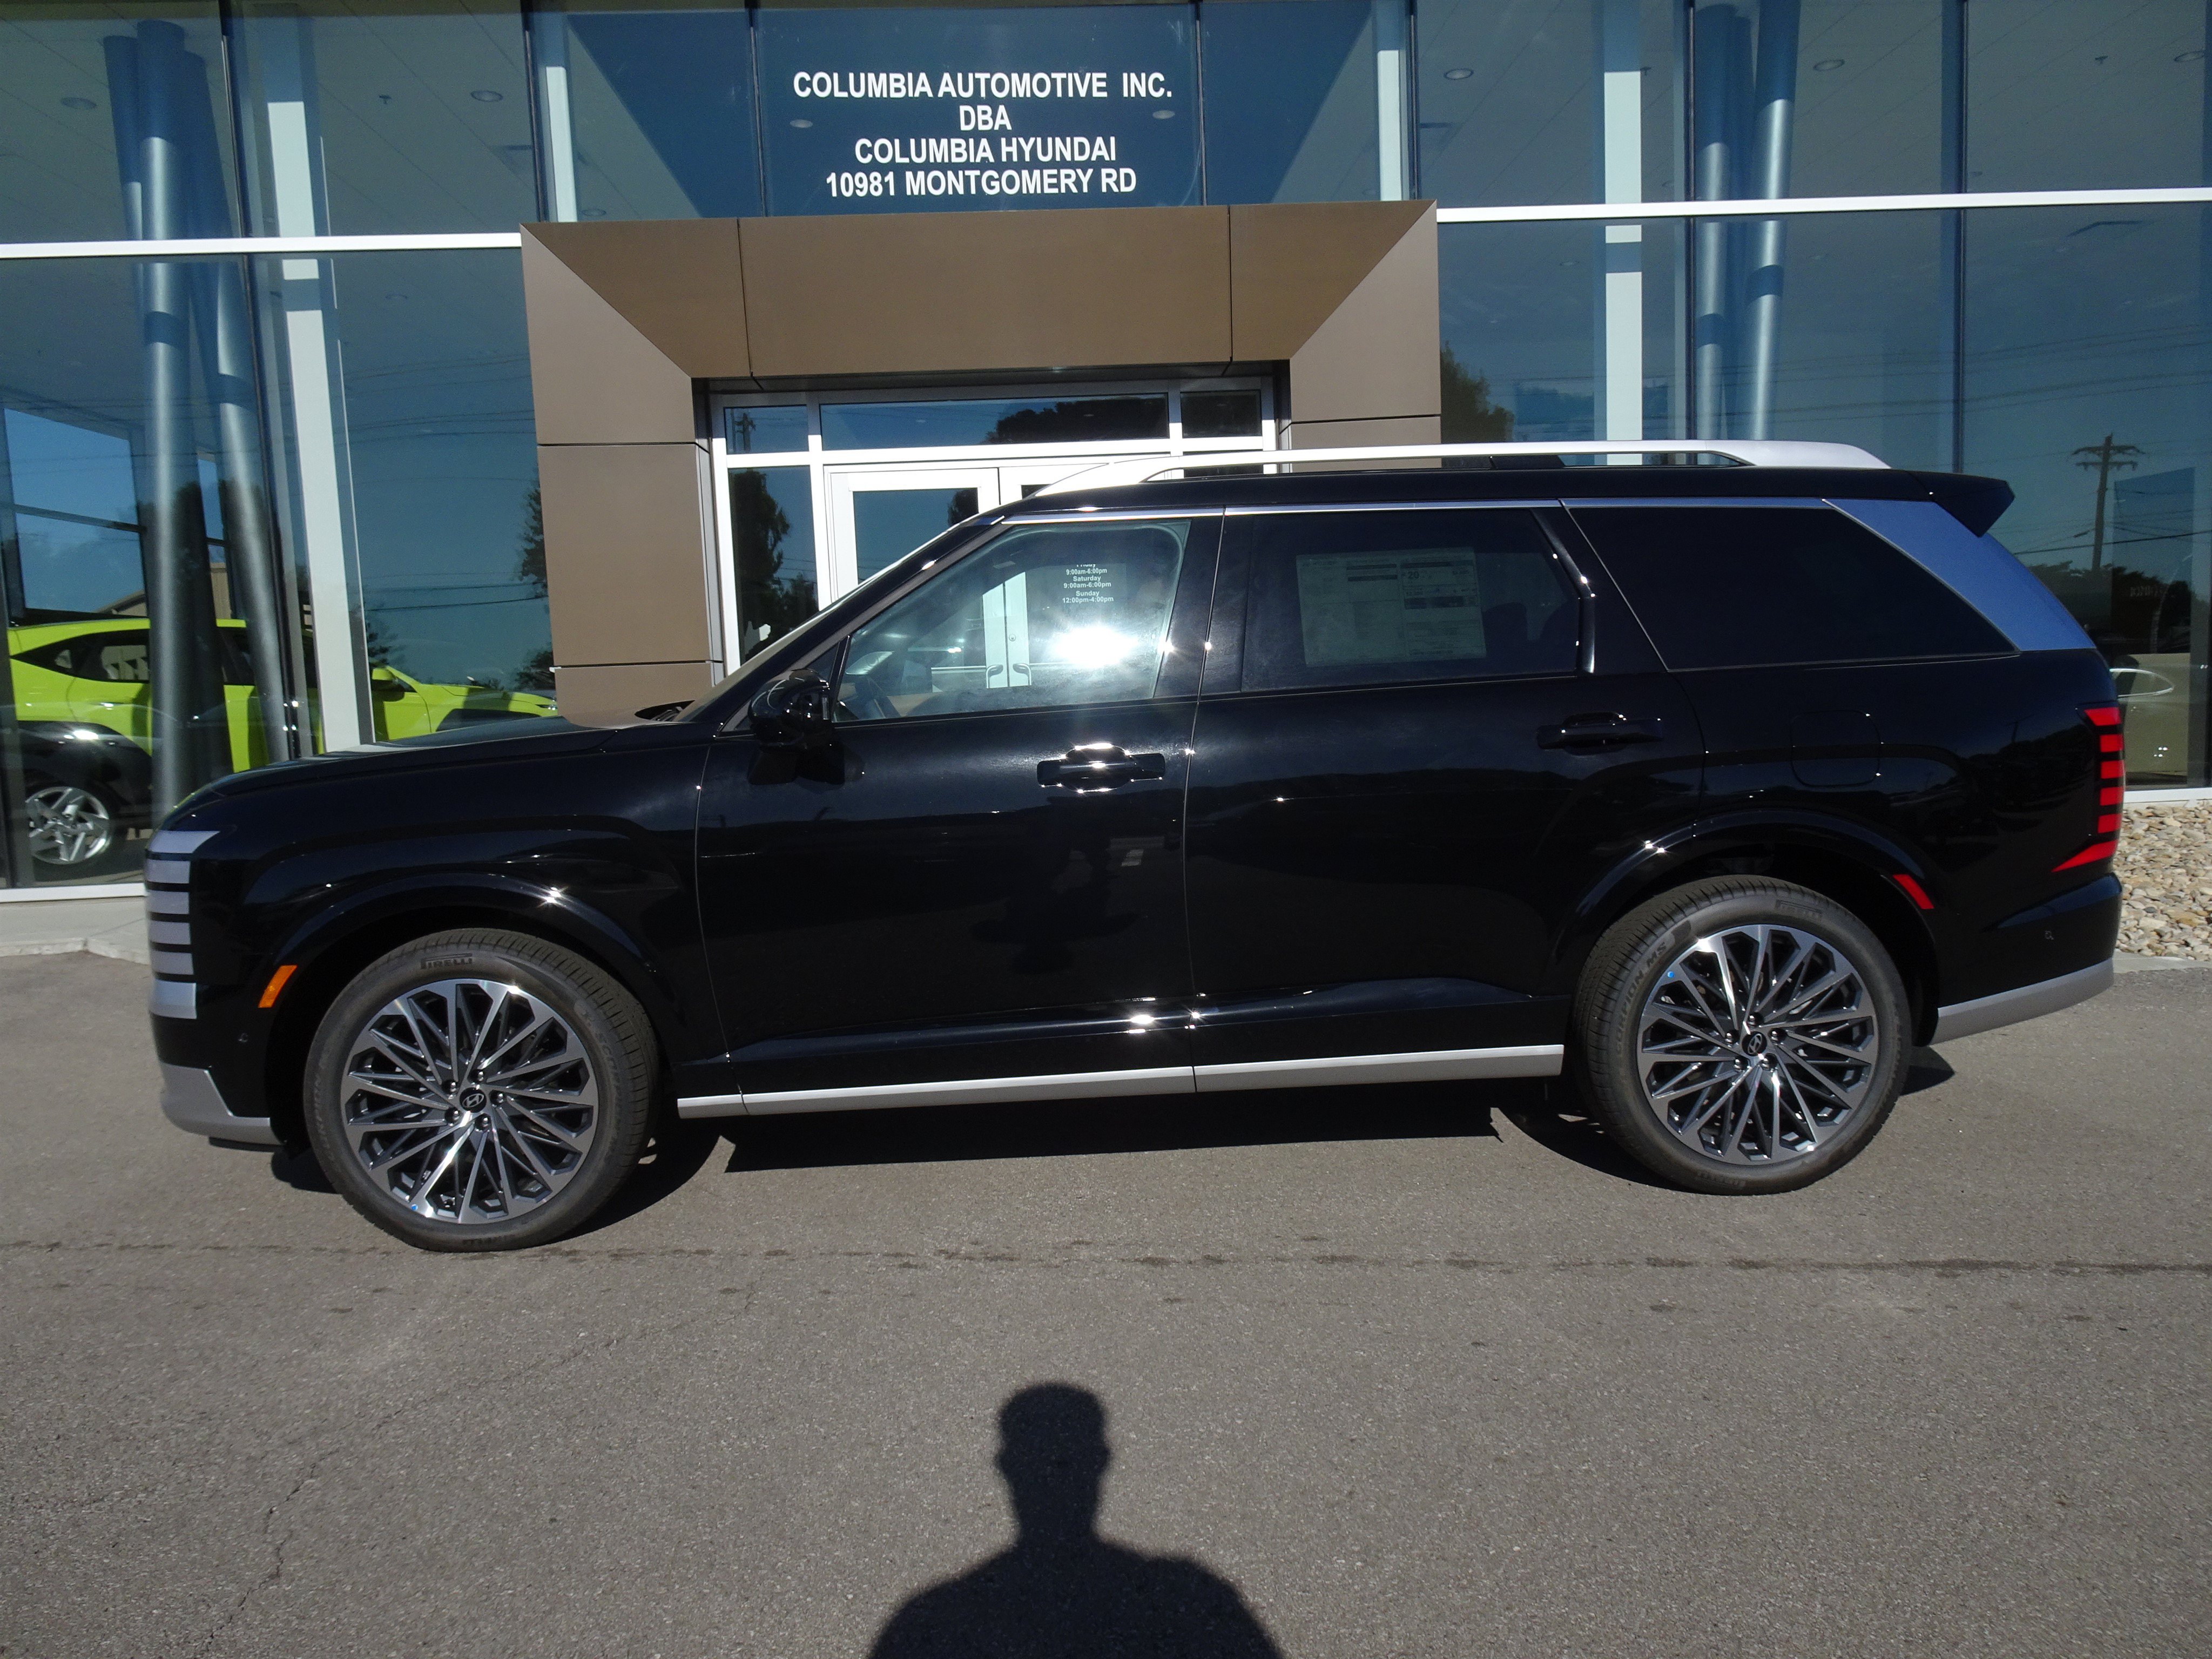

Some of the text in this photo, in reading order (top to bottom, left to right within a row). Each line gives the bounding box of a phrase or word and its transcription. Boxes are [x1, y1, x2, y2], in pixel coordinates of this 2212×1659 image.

[793, 71, 1172, 98] COLUMBIA AUTOMOTIVE INC.
[959, 105, 1012, 131] DBA
[855, 136, 1116, 164] COLUMBIA HYUNDAI
[826, 168, 1137, 197] 10981 MONTGOMERY RD
